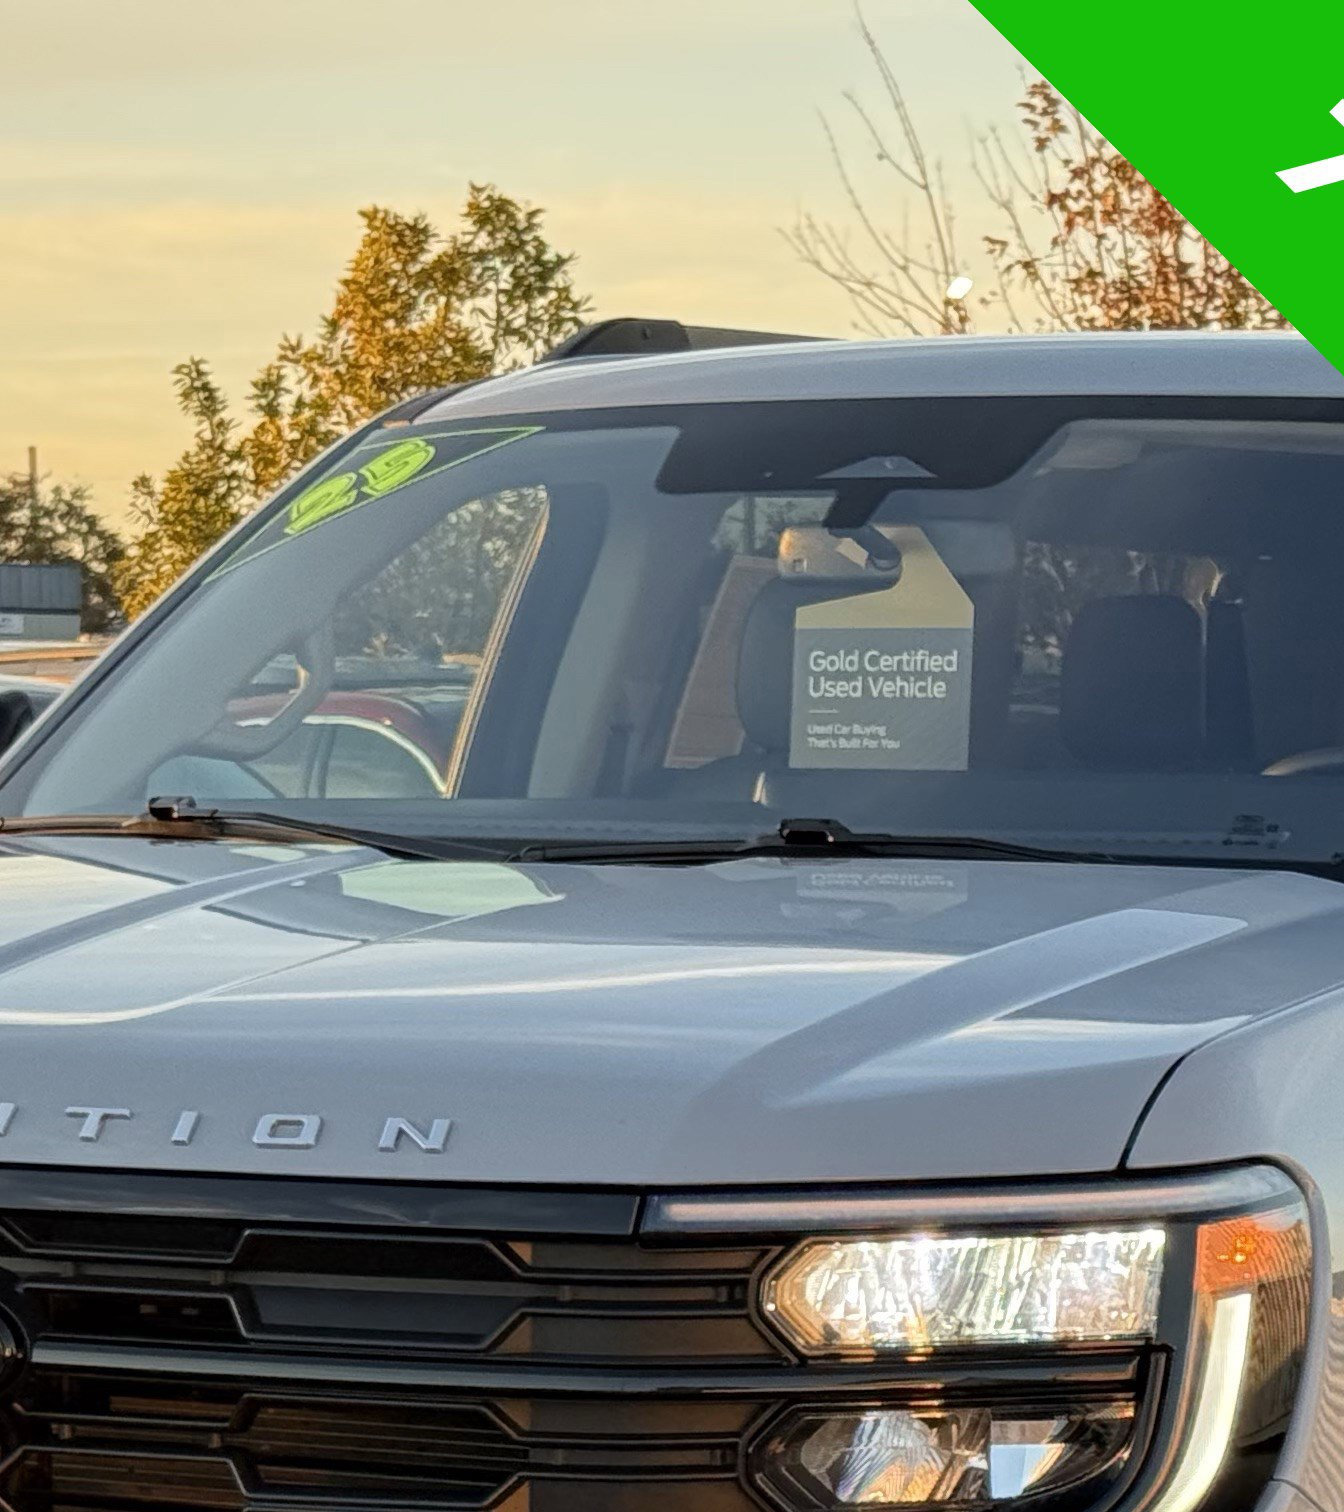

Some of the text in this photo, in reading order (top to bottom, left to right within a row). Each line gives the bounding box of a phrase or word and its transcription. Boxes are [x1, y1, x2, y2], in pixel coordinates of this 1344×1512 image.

[809, 649, 958, 672] Gold Certified
[808, 676, 947, 698] Used Vehicle
